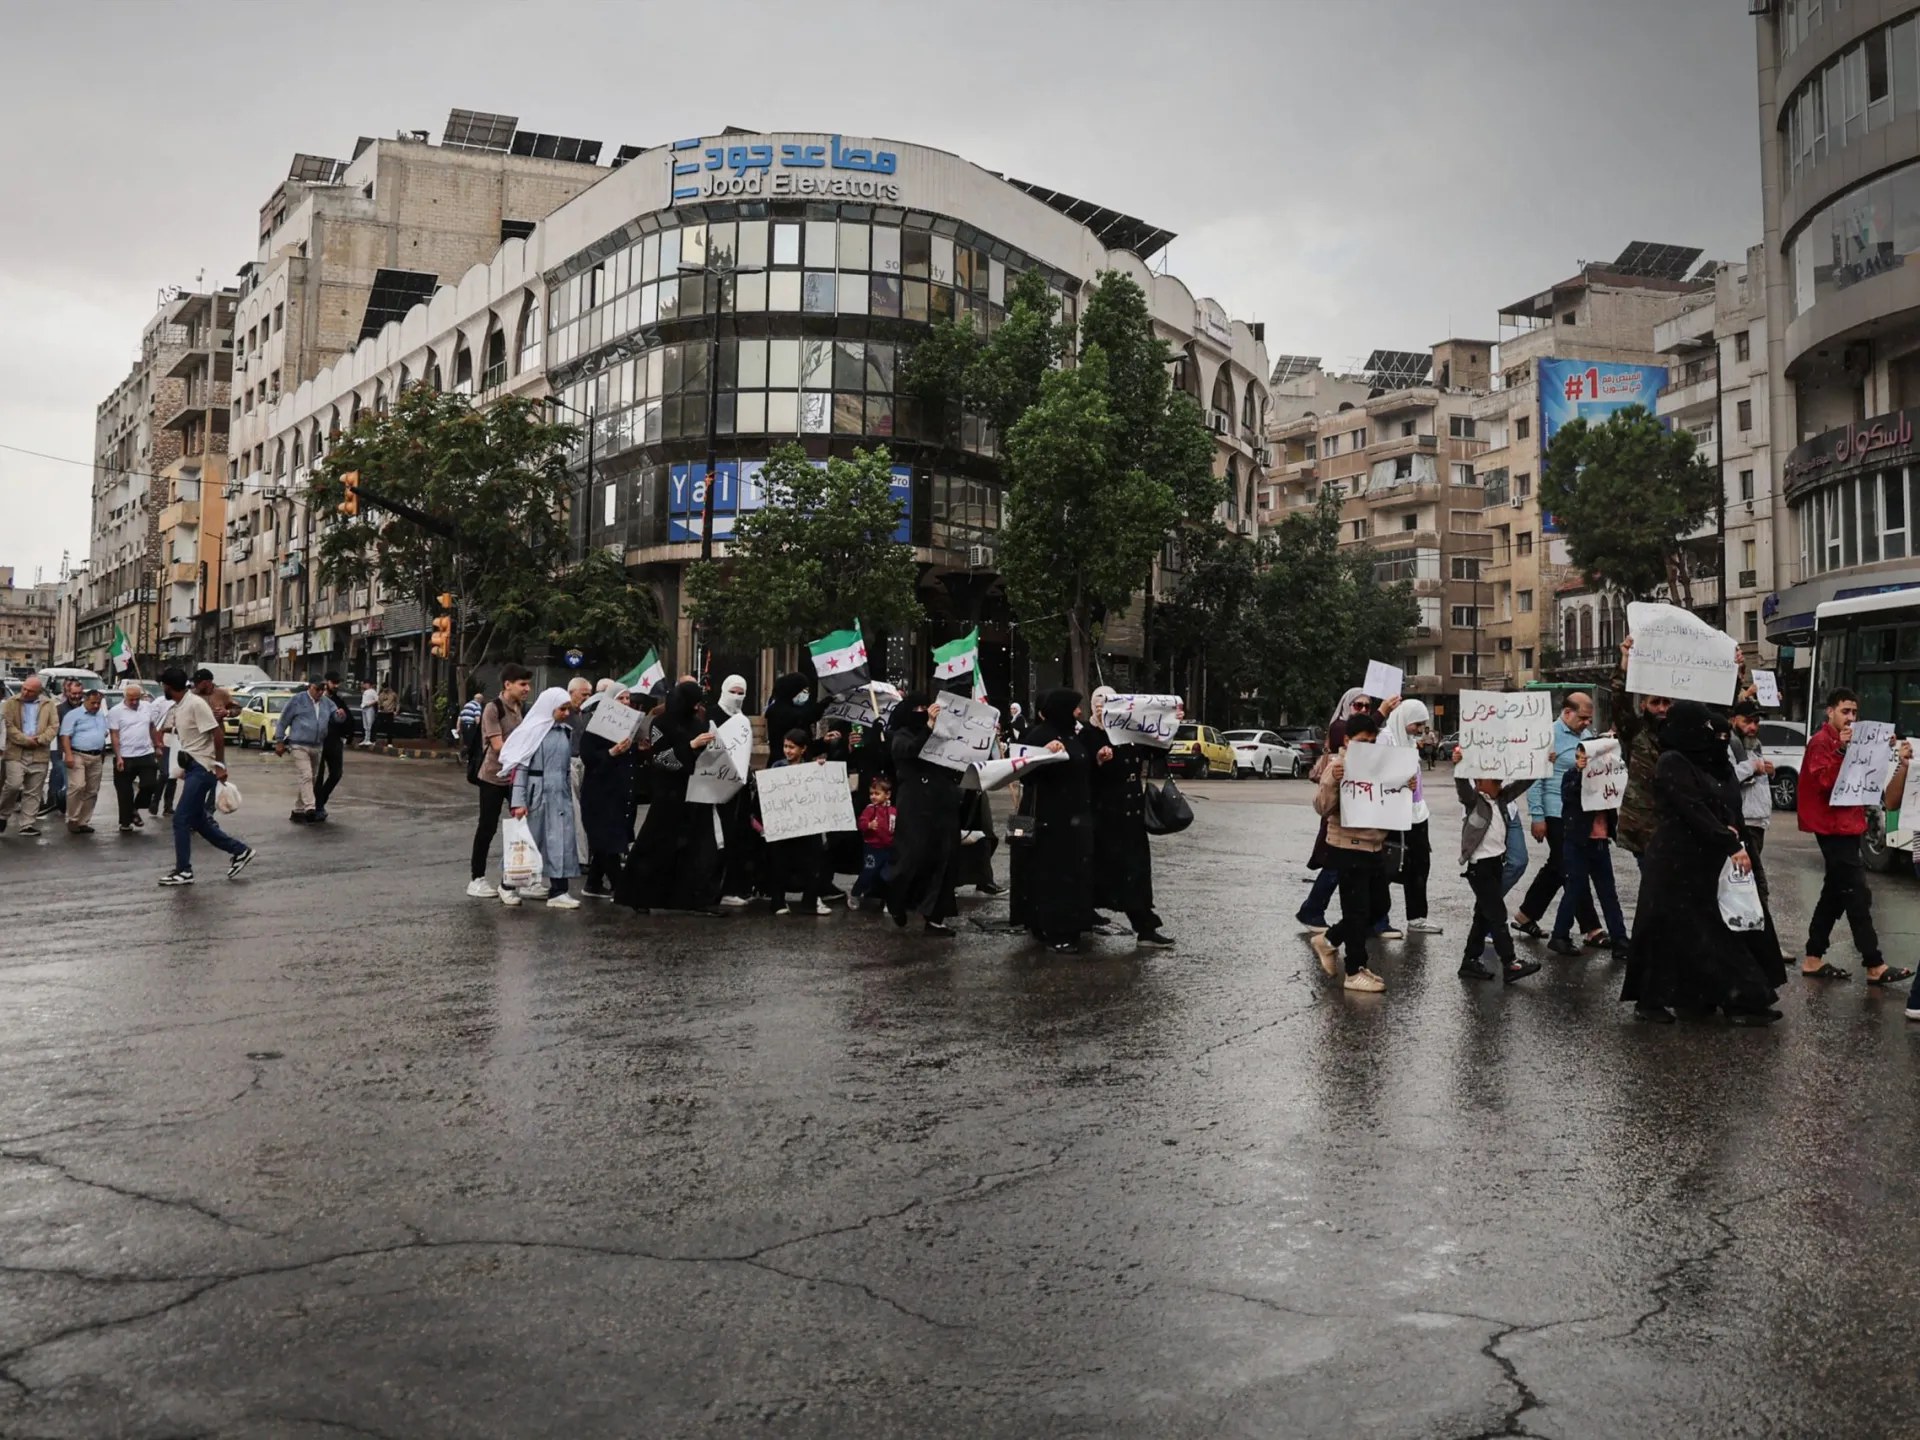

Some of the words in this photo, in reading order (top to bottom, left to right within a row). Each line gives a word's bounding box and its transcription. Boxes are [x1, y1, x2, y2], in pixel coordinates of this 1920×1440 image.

[704, 145, 773, 177] جود
[781, 134, 896, 174] مصاعد
[703, 174, 762, 198] Jood
[771, 173, 901, 200] Elevators
[1565, 368, 1598, 400] #1
[1461, 700, 1497, 722] عرض
[1496, 695, 1545, 719] الأرض
[972, 736, 991, 751] لا
[1532, 731, 1552, 751] لا
[1479, 752, 1534, 776] أعراضنا
[1354, 781, 1373, 802] خط
